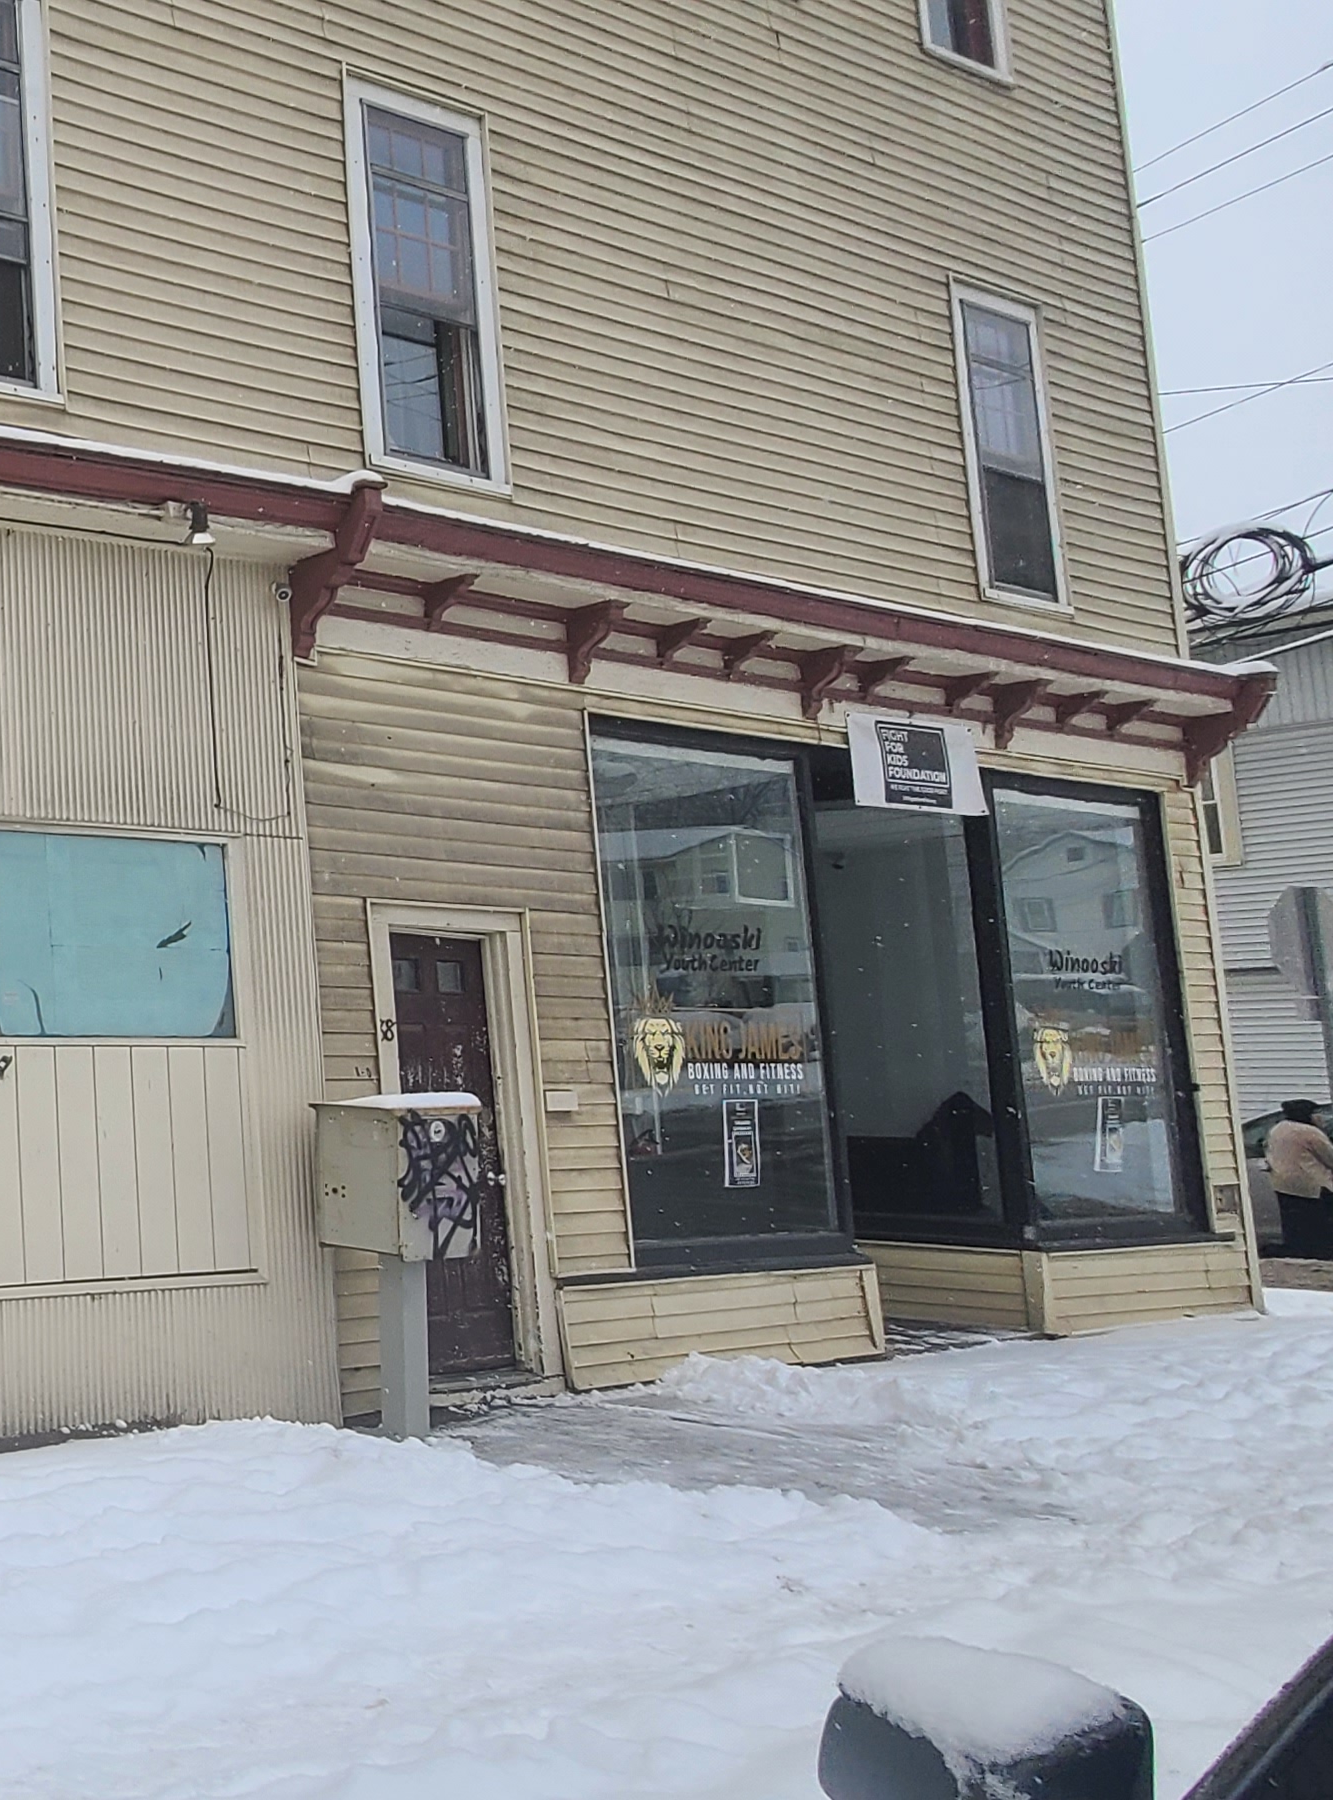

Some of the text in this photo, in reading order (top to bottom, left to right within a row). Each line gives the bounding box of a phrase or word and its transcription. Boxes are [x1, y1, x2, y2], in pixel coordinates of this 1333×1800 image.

[880, 729, 908, 742] FIGHT
[884, 741, 905, 753] FOR
[886, 754, 909, 767] KIDS
[888, 767, 947, 783] FOUNDATION
[660, 923, 762, 950] Winooski
[659, 952, 760, 974] Youth Center
[1049, 949, 1123, 975] Winooski
[685, 1019, 803, 1059] KING JAMES
[687, 1062, 804, 1080] BOXING AND FITNESS
